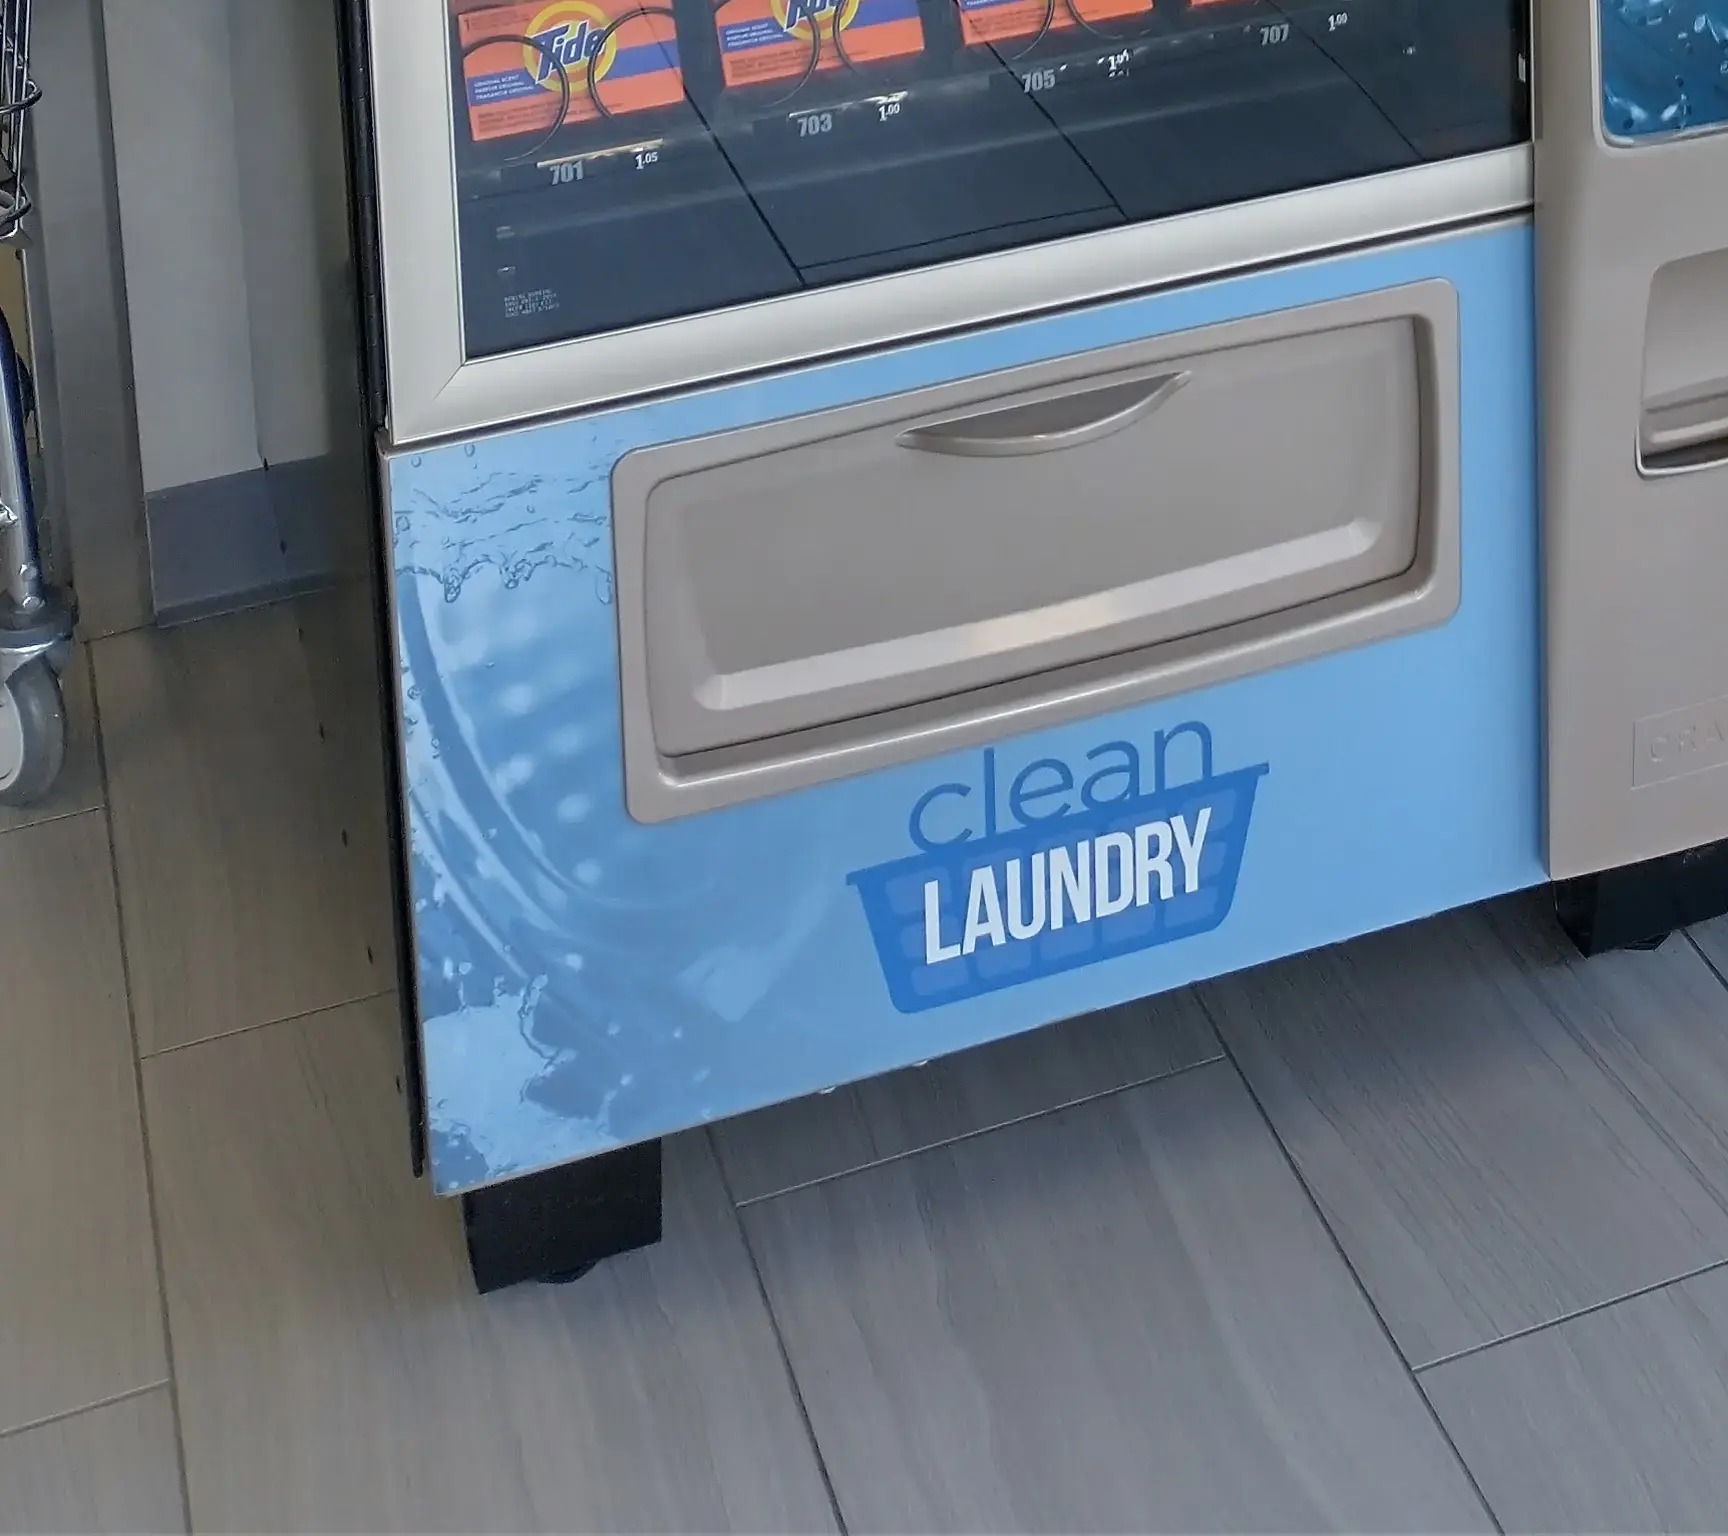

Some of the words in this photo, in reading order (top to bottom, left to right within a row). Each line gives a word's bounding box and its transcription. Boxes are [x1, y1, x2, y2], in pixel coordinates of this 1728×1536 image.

[1260, 24, 1291, 46] 707
[1328, 12, 1349, 32] 1.00
[531, 19, 607, 84] Tide
[1022, 69, 1056, 93] 705
[797, 113, 833, 137] 703
[878, 103, 901, 122] 1.00
[550, 161, 584, 185] 701
[635, 151, 659, 170] 1.05
[909, 721, 1213, 853] clean
[924, 807, 1212, 965] LAUNDRY
